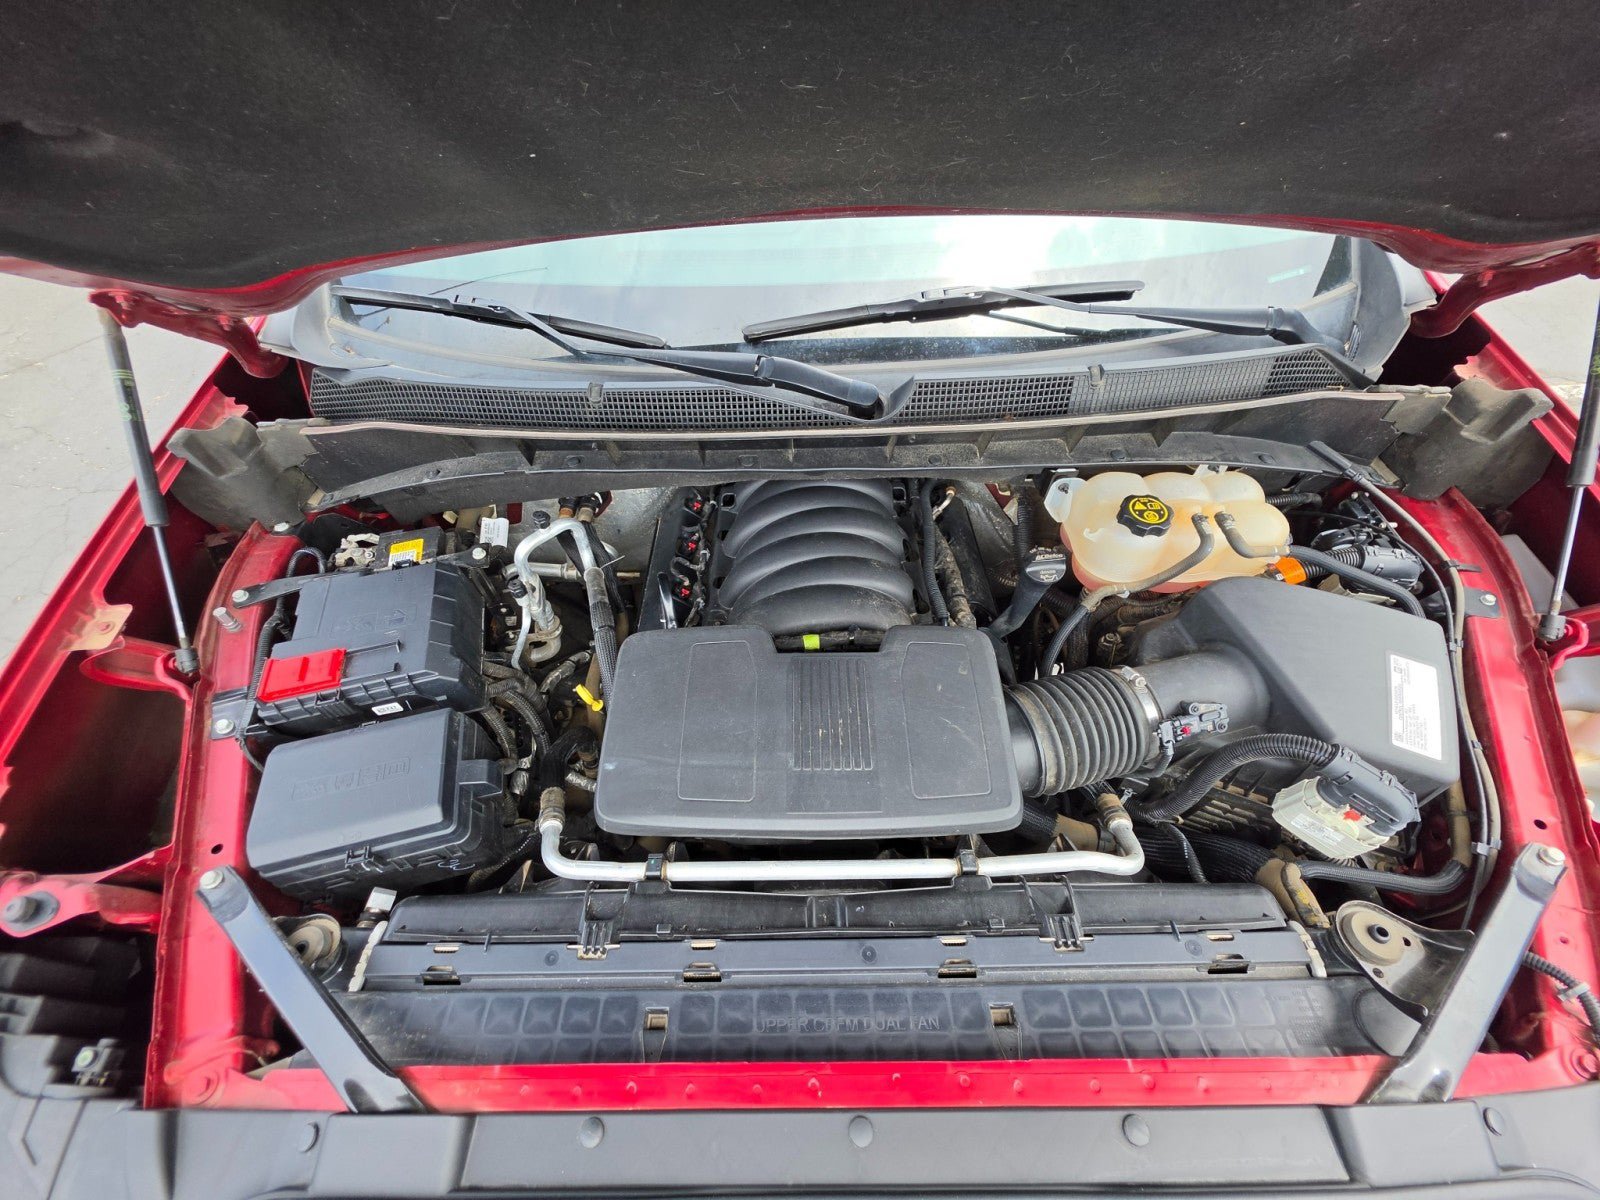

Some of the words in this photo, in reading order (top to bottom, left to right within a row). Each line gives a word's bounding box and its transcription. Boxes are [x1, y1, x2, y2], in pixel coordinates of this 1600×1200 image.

[753, 1016, 811, 1033] UPPER
[863, 1015, 906, 1031] DUAL
[909, 1015, 941, 1031] FAN
